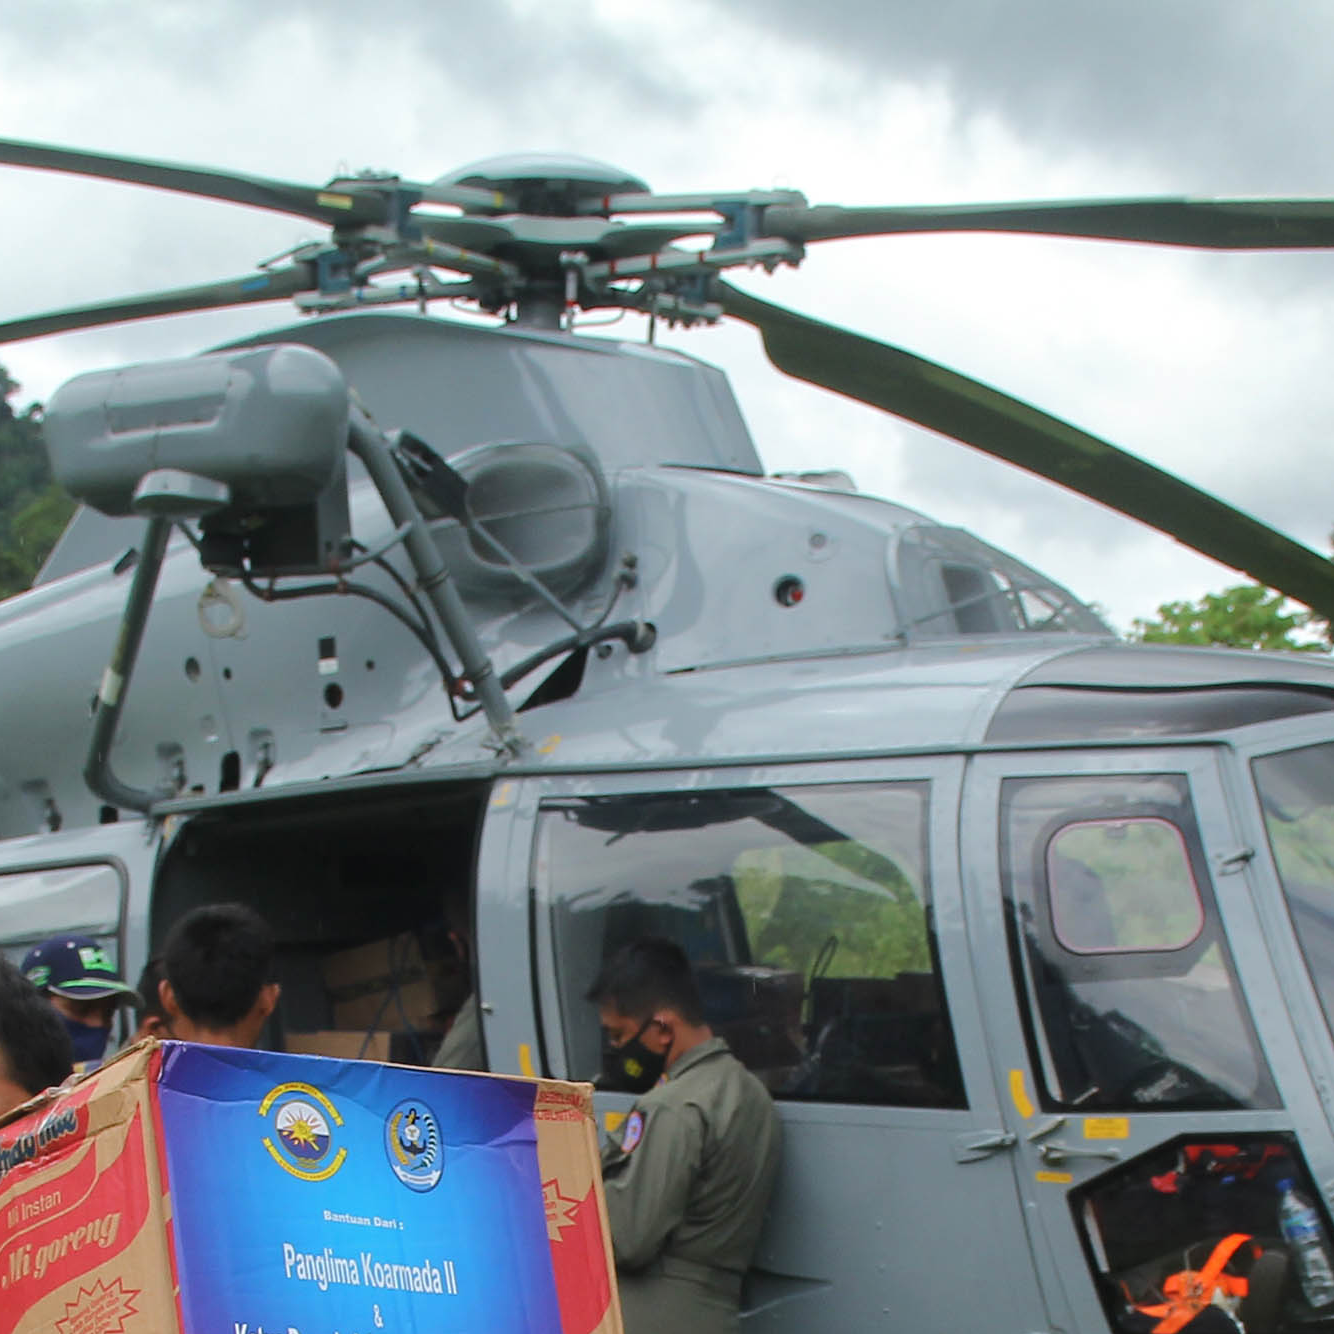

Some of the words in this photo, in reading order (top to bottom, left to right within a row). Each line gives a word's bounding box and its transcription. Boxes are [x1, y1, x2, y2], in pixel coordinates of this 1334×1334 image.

[22, 1190, 61, 1220] Instan
[323, 1210, 371, 1226] Bantuan
[374, 1216, 397, 1229] Dari
[33, 1212, 122, 1279] goreng
[282, 1242, 360, 1292] Panglima
[360, 1251, 443, 1294] Koarmada
[443, 1260, 458, 1295] II
[373, 1303, 384, 1329] &
